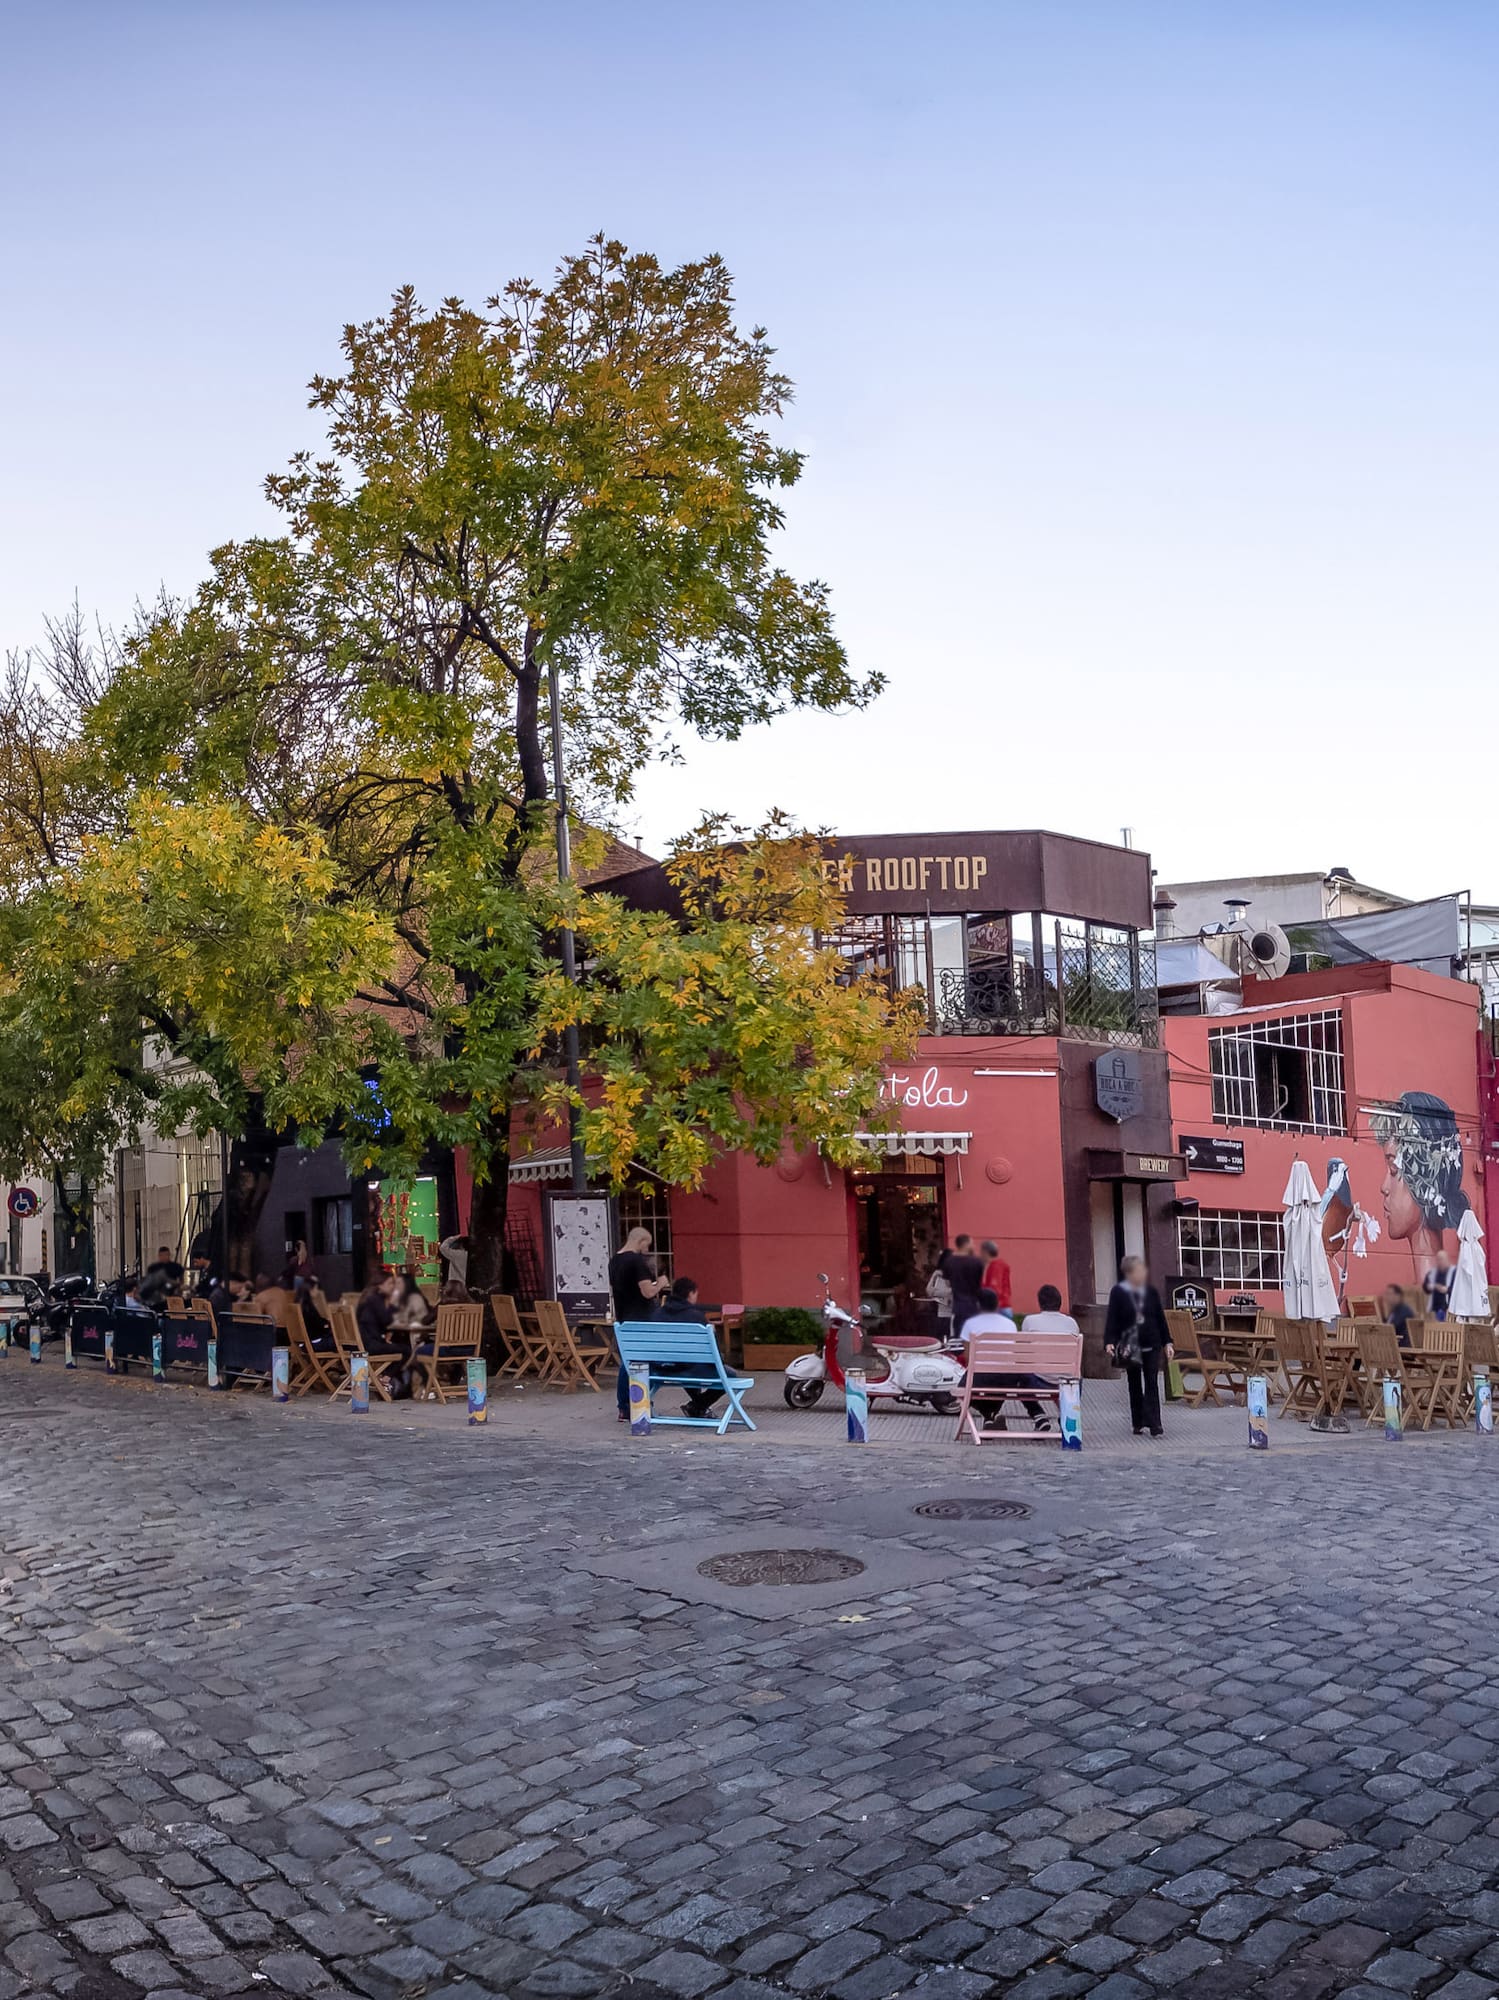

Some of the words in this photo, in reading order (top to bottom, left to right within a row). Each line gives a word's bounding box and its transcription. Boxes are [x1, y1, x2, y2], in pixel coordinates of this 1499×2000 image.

[865, 856, 988, 892] ROOFTOP
[833, 1066, 968, 1108] tola
[1140, 1158, 1169, 1172] BREWERY
